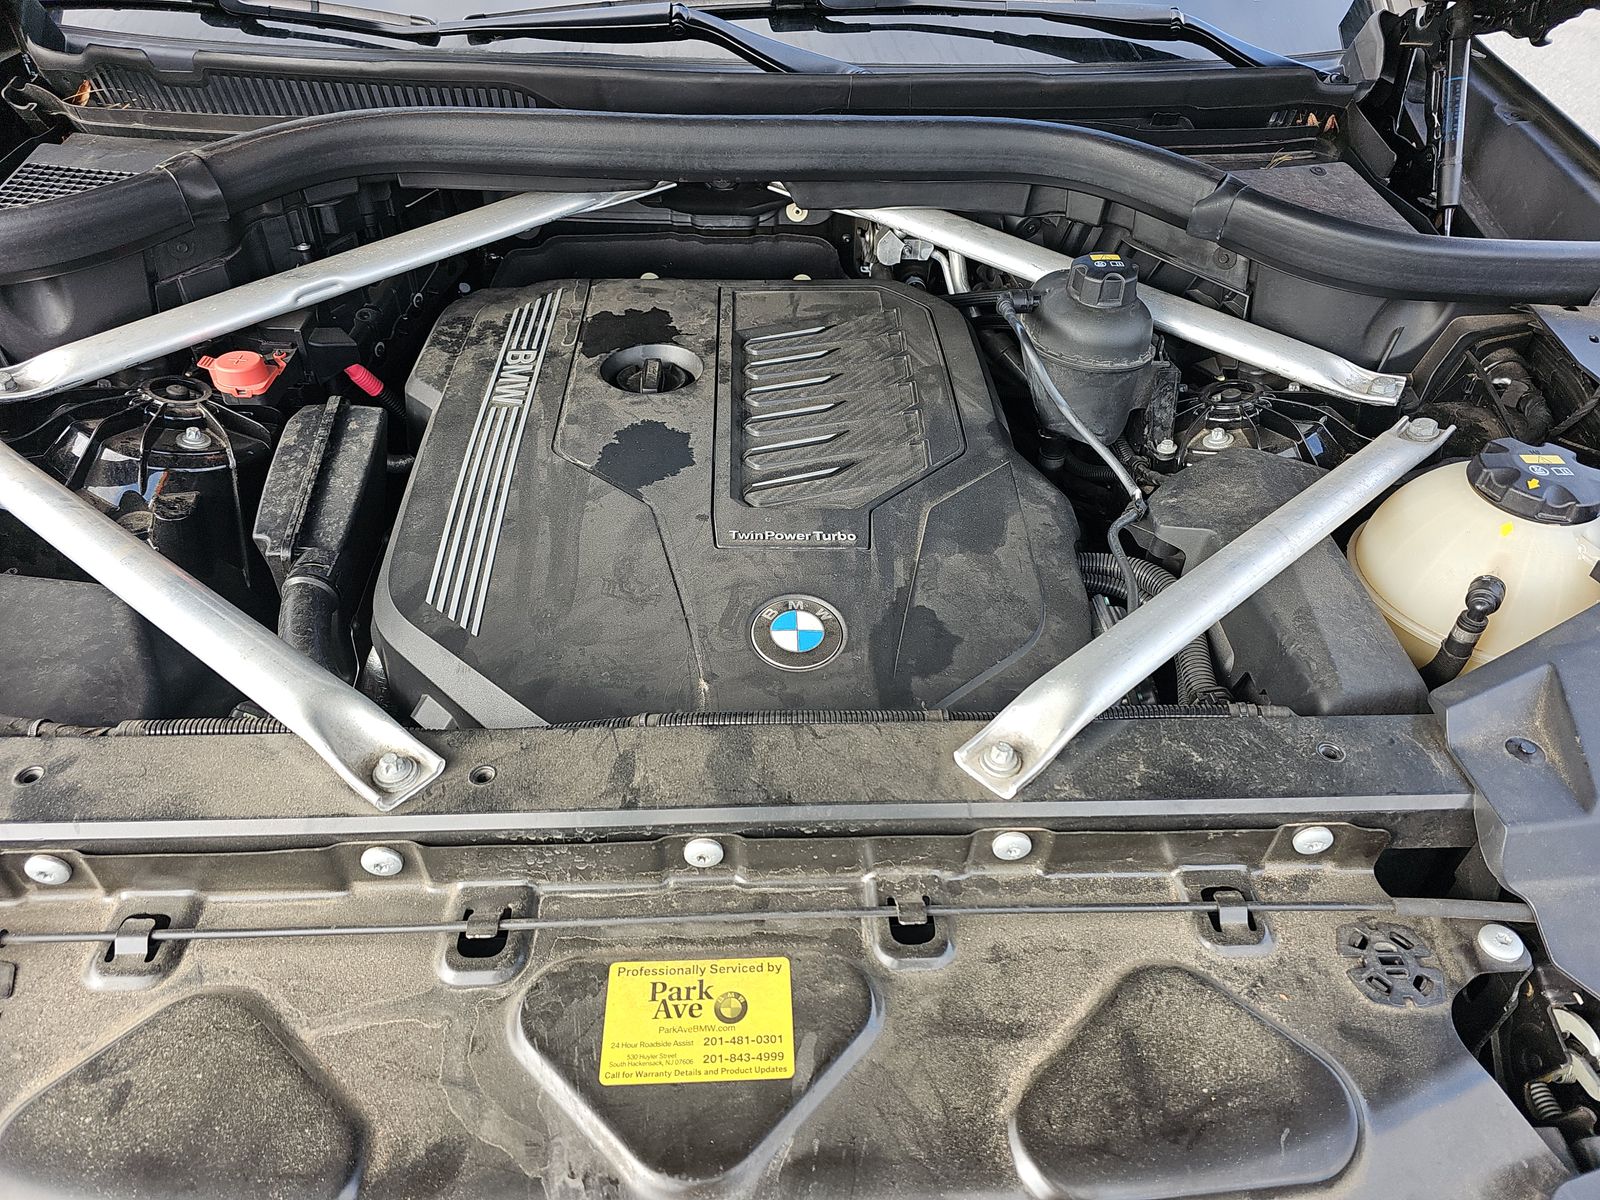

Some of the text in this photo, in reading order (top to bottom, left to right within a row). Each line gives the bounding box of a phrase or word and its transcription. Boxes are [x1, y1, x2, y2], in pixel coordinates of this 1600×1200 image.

[492, 350, 538, 405] BMW
[812, 531, 857, 541] Turbo
[761, 600, 833, 621] BMW
[617, 962, 782, 977] Professionally Serviced by
[648, 979, 714, 1002] Park
[652, 999, 703, 1019] Ave
[658, 1025, 736, 1034] ParkAveBMW.com
[621, 1041, 638, 1049] Hour
[640, 1040, 672, 1048] Roadside
[703, 1034, 783, 1046] 201-481-0301
[703, 1051, 784, 1063] 201-843-4999
[604, 1071, 620, 1079] Call
[635, 1070, 672, 1078] Warranty
[674, 1068, 701, 1077] Details
[721, 1067, 753, 1075] Product
[754, 1066, 788, 1074] Updates
